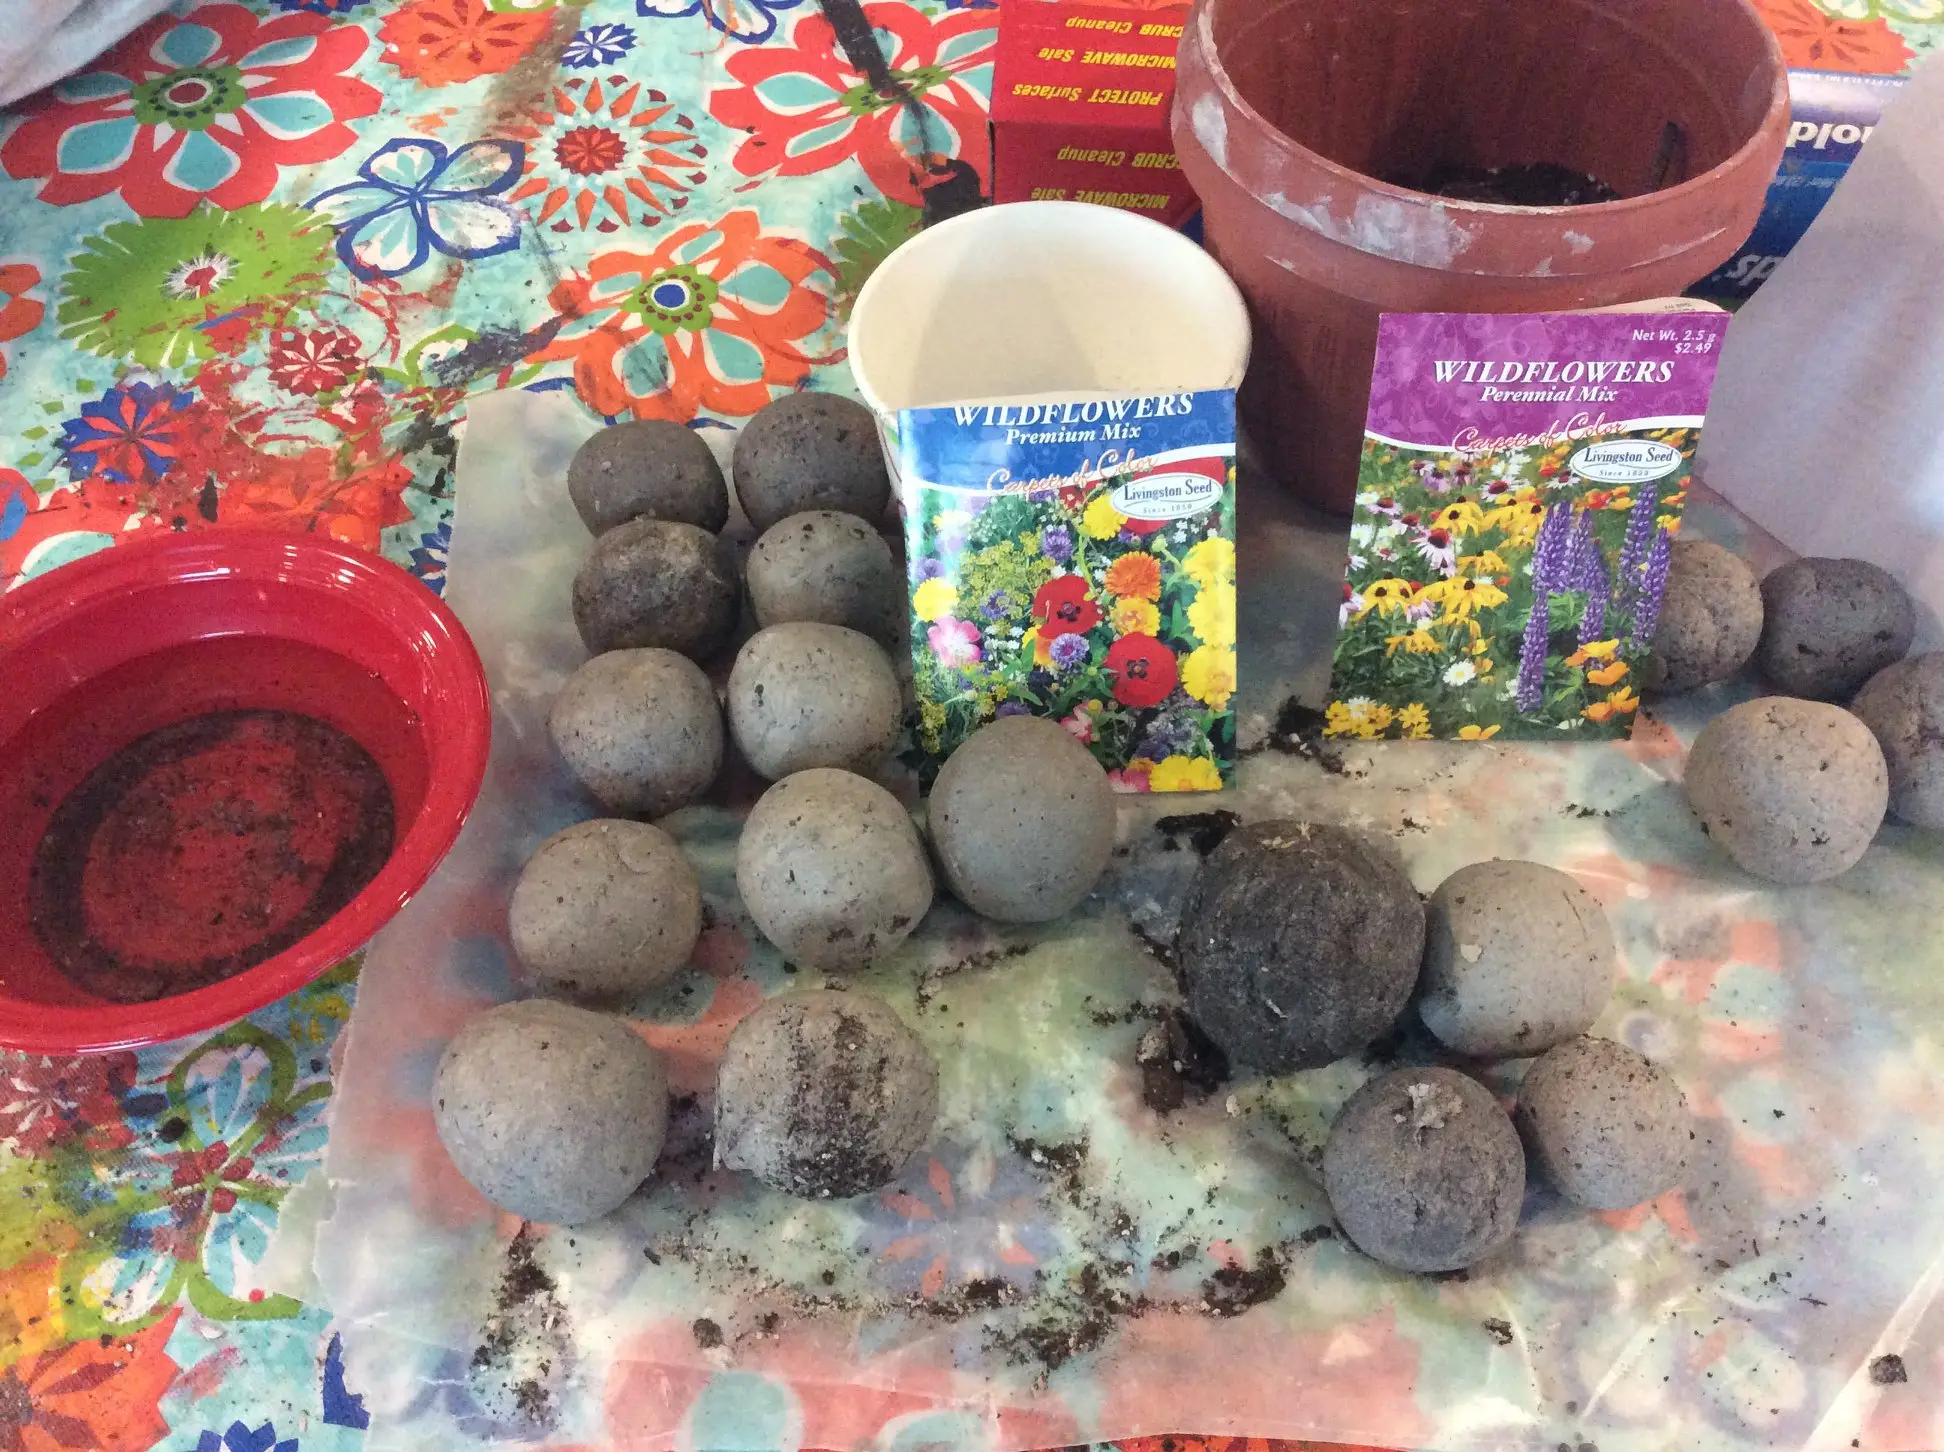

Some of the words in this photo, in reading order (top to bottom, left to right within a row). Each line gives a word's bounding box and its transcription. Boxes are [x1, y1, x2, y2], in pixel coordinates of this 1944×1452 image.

[1065, 15, 1133, 35] Cleanup
[1138, 23, 1184, 38] CRUB
[1038, 47, 1075, 63] Safe
[1081, 53, 1176, 69] MICROWAVE
[1012, 83, 1082, 101] Surfaces
[1088, 88, 1163, 106] PROTECT
[1057, 145, 1126, 167] Cleanup
[1131, 152, 1181, 170] CRUB
[1031, 187, 1066, 201] Safe
[1075, 190, 1170, 209] MICROWAVE
[1632, 328, 1655, 341] Net
[1659, 328, 1679, 341] Wt.
[1682, 329, 1706, 341] 2.5
[1708, 333, 1716, 343] g
[1674, 342, 1712, 354] $2.49
[1433, 360, 1675, 384] WILDFLOWERS
[1478, 385, 1574, 403] Perennial
[1577, 386, 1619, 403] Mix
[953, 392, 1195, 427] WILDFLOWERS
[1004, 426, 1097, 446] Premium
[1101, 422, 1142, 442] Mix
[1451, 425, 1533, 459] Carpets
[1538, 419, 1561, 450] of
[1565, 411, 1628, 441] Color
[1583, 447, 1643, 465] Livingston
[1646, 446, 1674, 462] Seed
[1072, 458, 1094, 488] of
[1096, 447, 1159, 477] Color
[1123, 485, 1182, 501] Livingston
[1185, 479, 1212, 495] Seed
